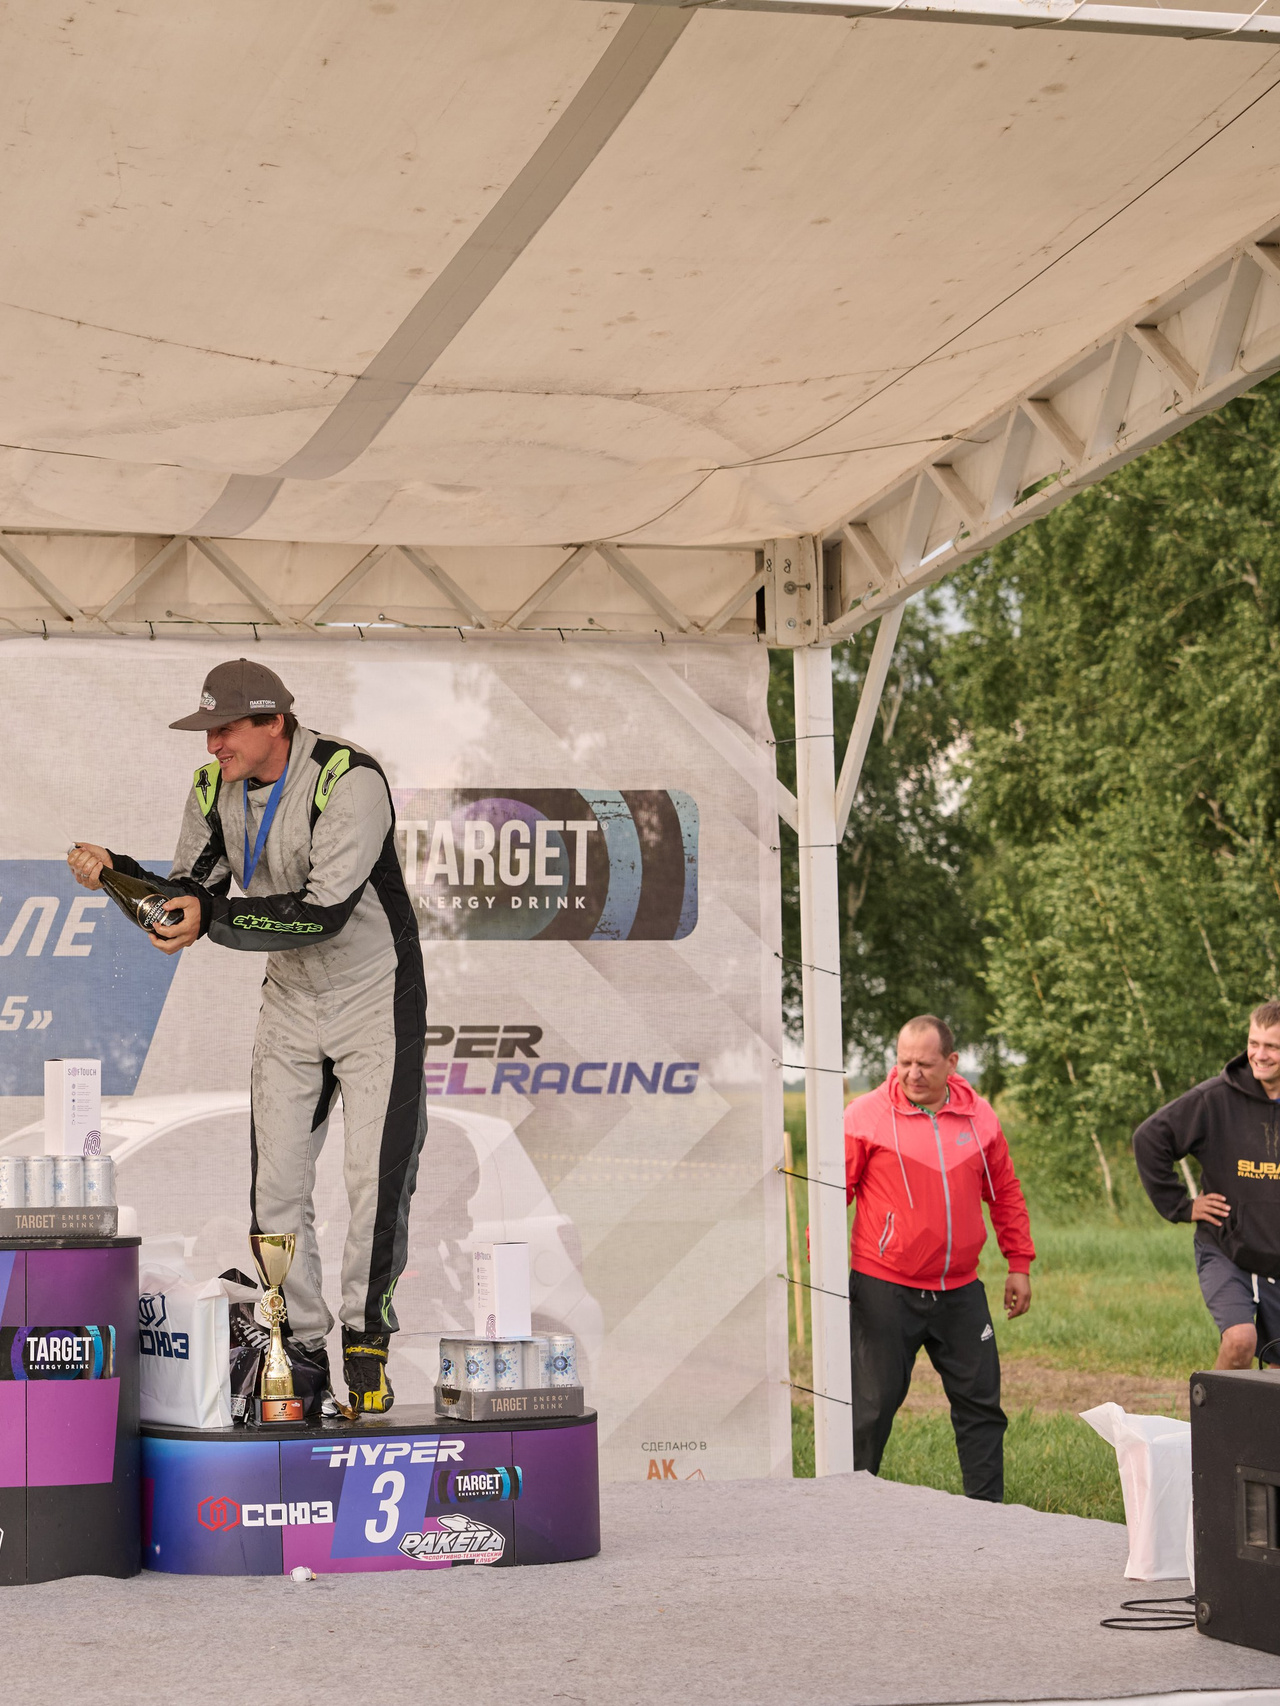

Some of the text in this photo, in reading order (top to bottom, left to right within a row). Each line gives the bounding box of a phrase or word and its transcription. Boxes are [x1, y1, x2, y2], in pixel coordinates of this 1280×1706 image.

[396, 819, 598, 887] TARGET
[419, 895, 587, 910] NERGY DRINK
[233, 914, 324, 934] alpinestars
[424, 1025, 544, 1059] PER
[1238, 1171, 1265, 1180] RALLY
[15, 1213, 102, 1229] TARGET ENERGY
[27, 1336, 91, 1362] TARGET
[139, 1328, 190, 1360] ОЮЗ
[280, 1402, 288, 1411] 3
[491, 1394, 570, 1413] TARGET ENERGY
[329, 1440, 465, 1468] HYPER
[641, 1441, 708, 1452] СДЕЛАНО В
[456, 1474, 500, 1491] TARGET
[242, 1501, 334, 1527] СОЮЗ
[365, 1470, 406, 1544] 3
[400, 1531, 502, 1555] РАКЕТА
[427, 1552, 503, 1561] СПОРТИВНО-ТЕХНИЧЕСКИЙ
